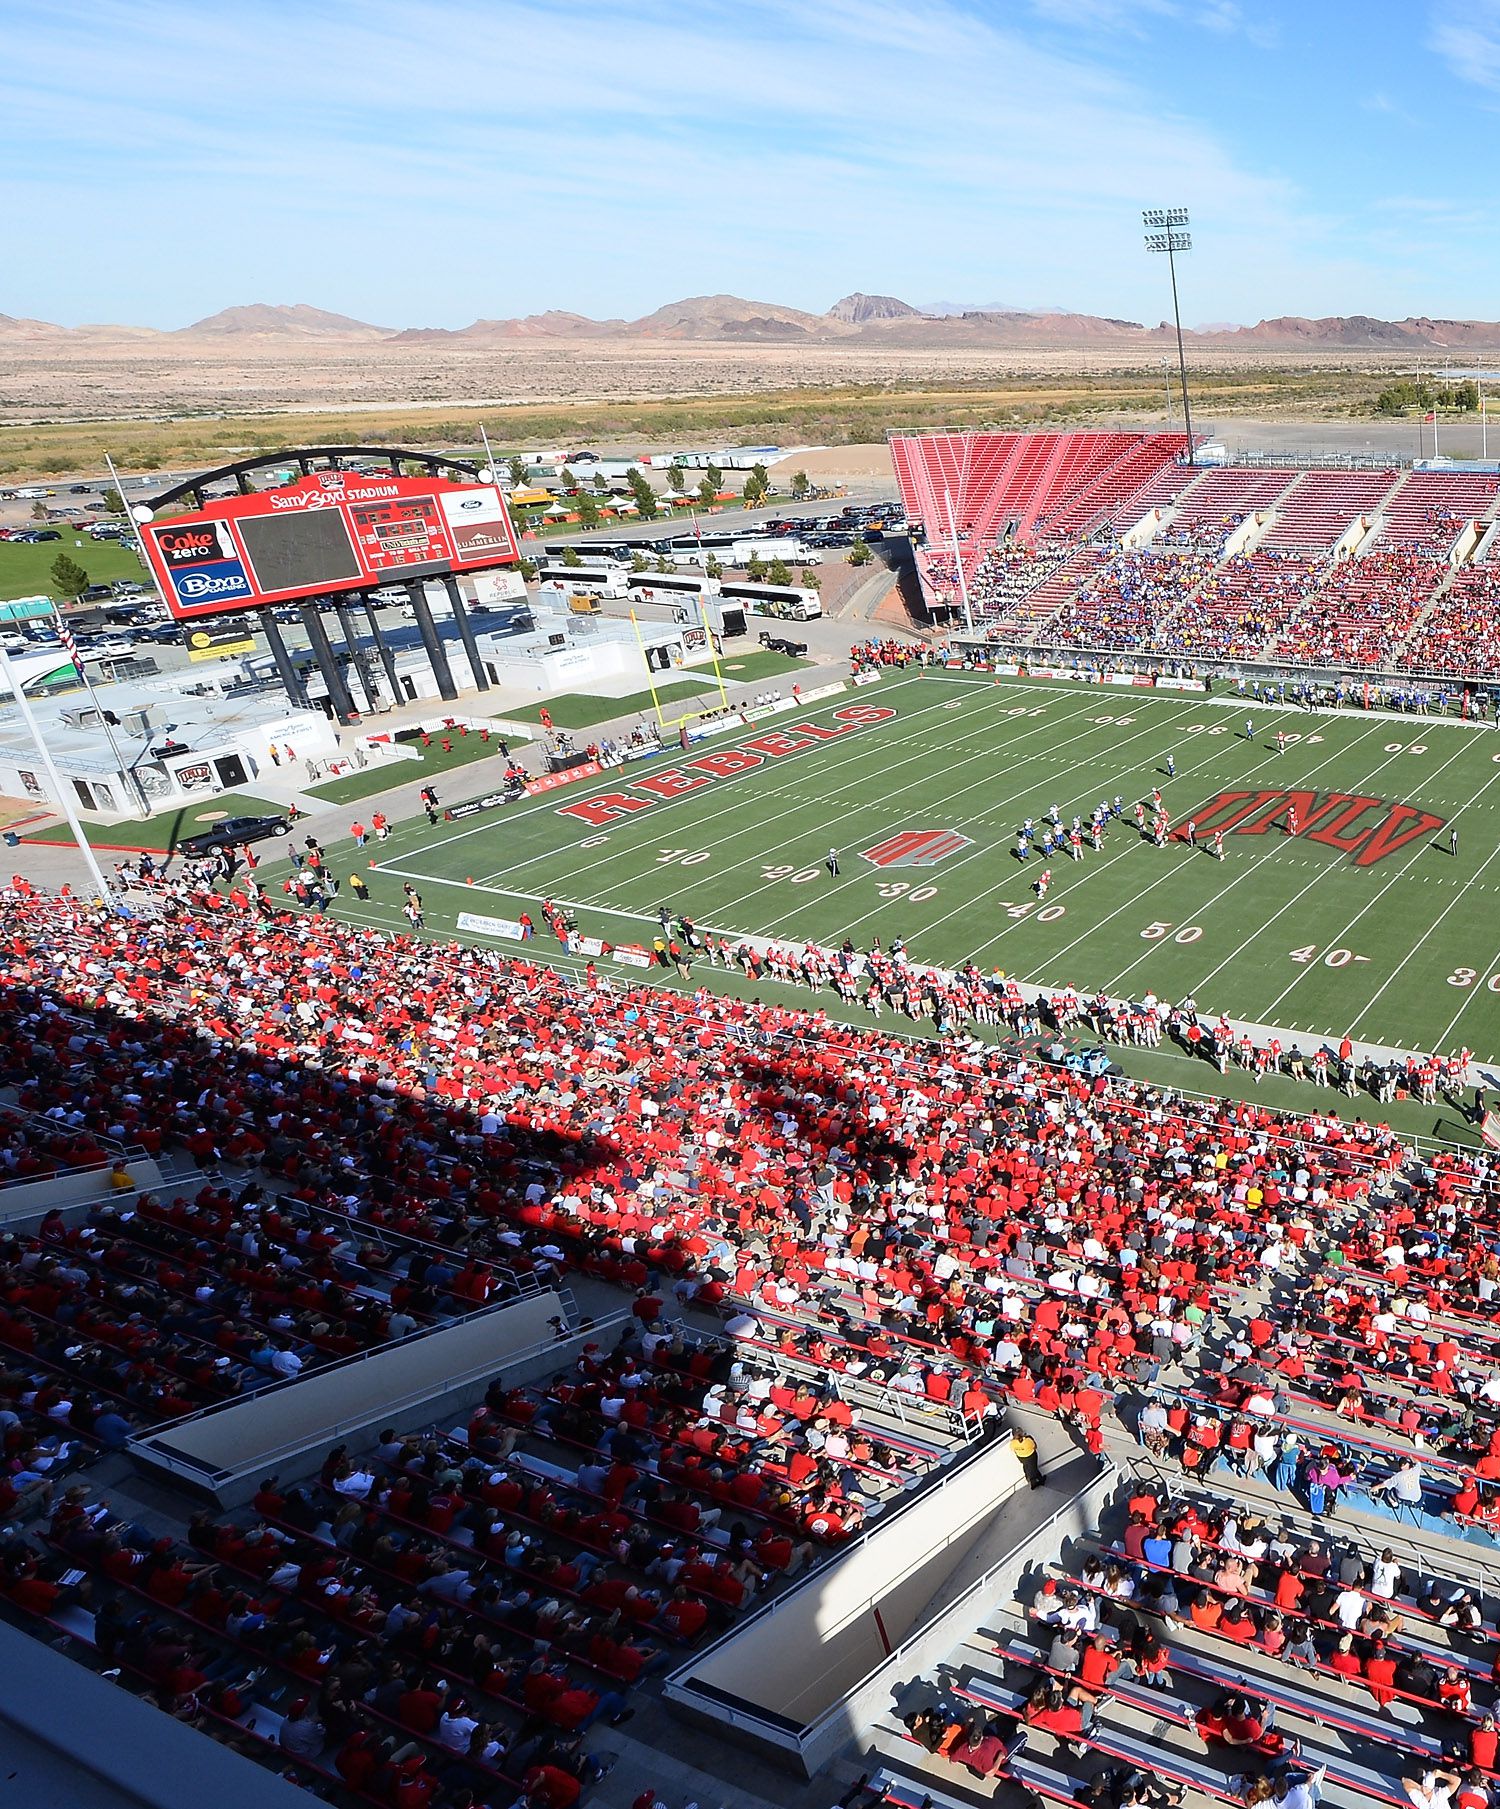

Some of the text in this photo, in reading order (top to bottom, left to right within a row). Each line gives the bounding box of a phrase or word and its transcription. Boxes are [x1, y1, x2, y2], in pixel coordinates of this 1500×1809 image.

[270, 485, 399, 509] Sam Boyd STADIUM
[159, 532, 213, 551] Coke
[457, 536, 508, 549] SUMMERLIN
[1384, 743, 1429, 755] 50
[555, 704, 897, 827] REBELS
[178, 767, 210, 784] UNLV
[1167, 789, 1448, 868] UNLV
[656, 849, 711, 865] 10
[763, 865, 821, 883] 20
[879, 883, 938, 902] 30
[1007, 901, 1066, 922] 40
[1140, 922, 1203, 943] 50
[1289, 945, 1353, 967] 40
